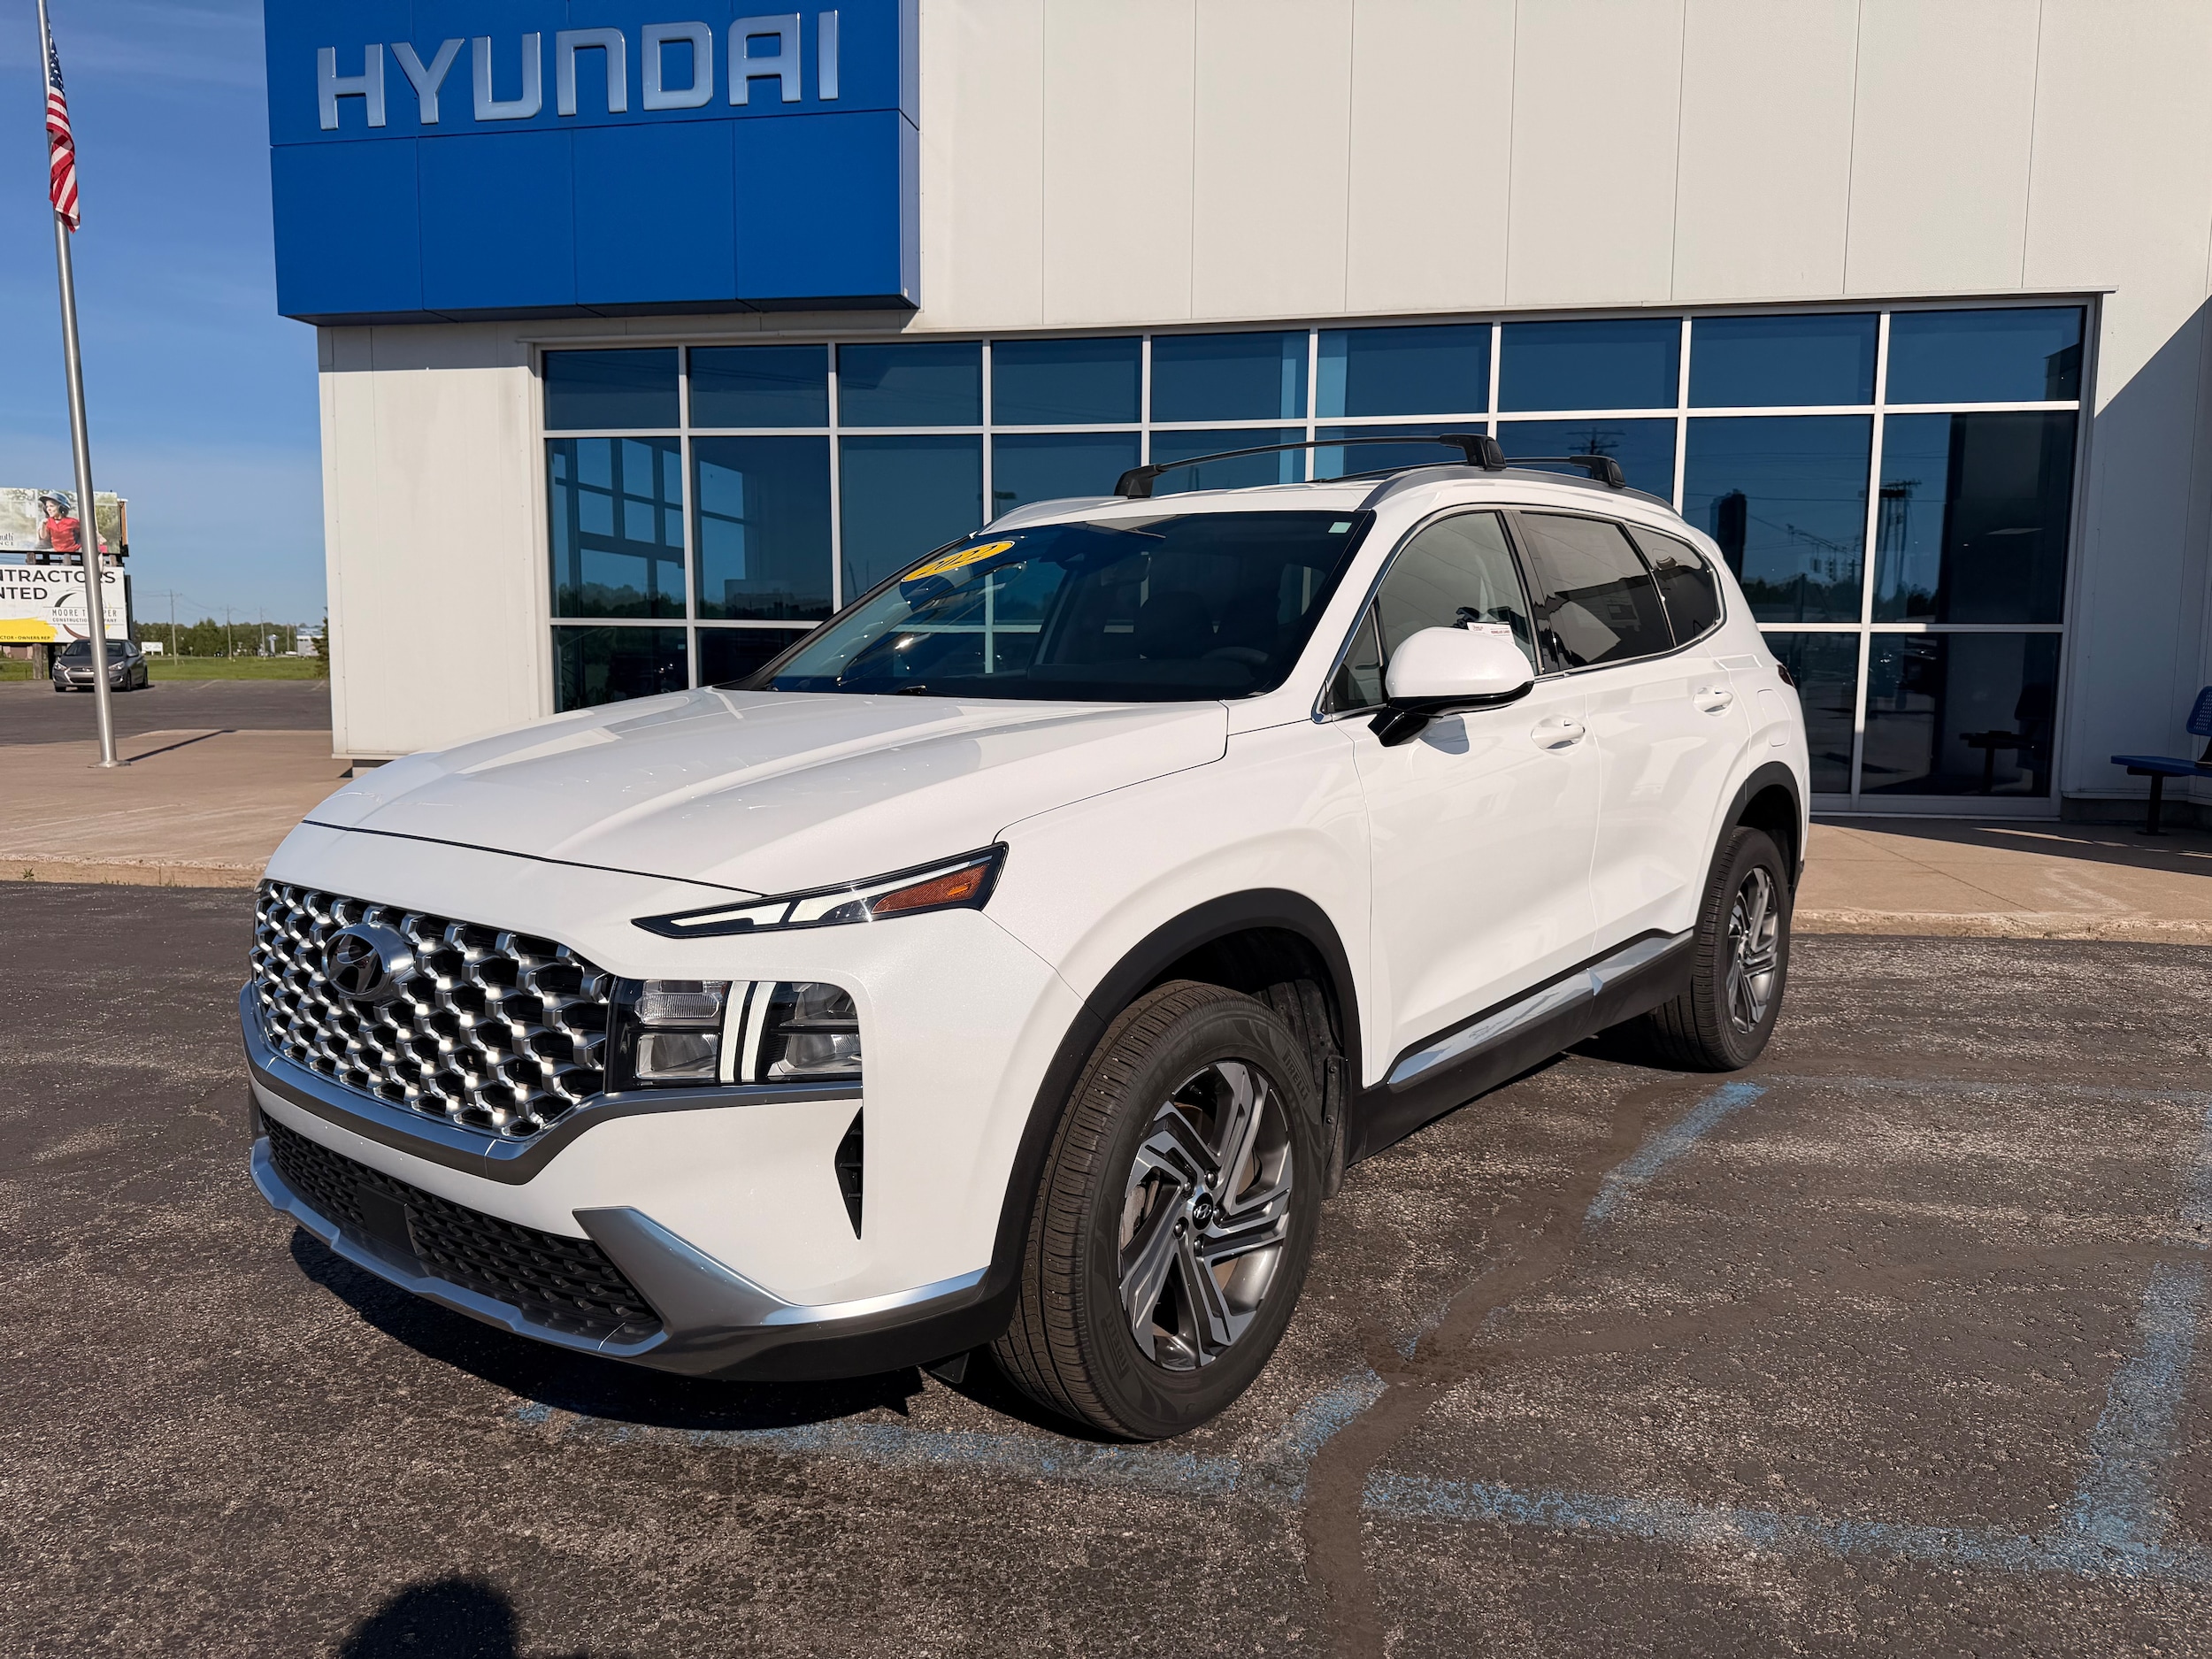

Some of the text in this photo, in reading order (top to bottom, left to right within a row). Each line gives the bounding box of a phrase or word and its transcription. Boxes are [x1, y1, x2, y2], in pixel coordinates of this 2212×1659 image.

[317, 9, 839, 130] HYUNDAI
[0, 569, 116, 584] TRACTOS
[1282, 1050, 1310, 1101] PIRELLI
